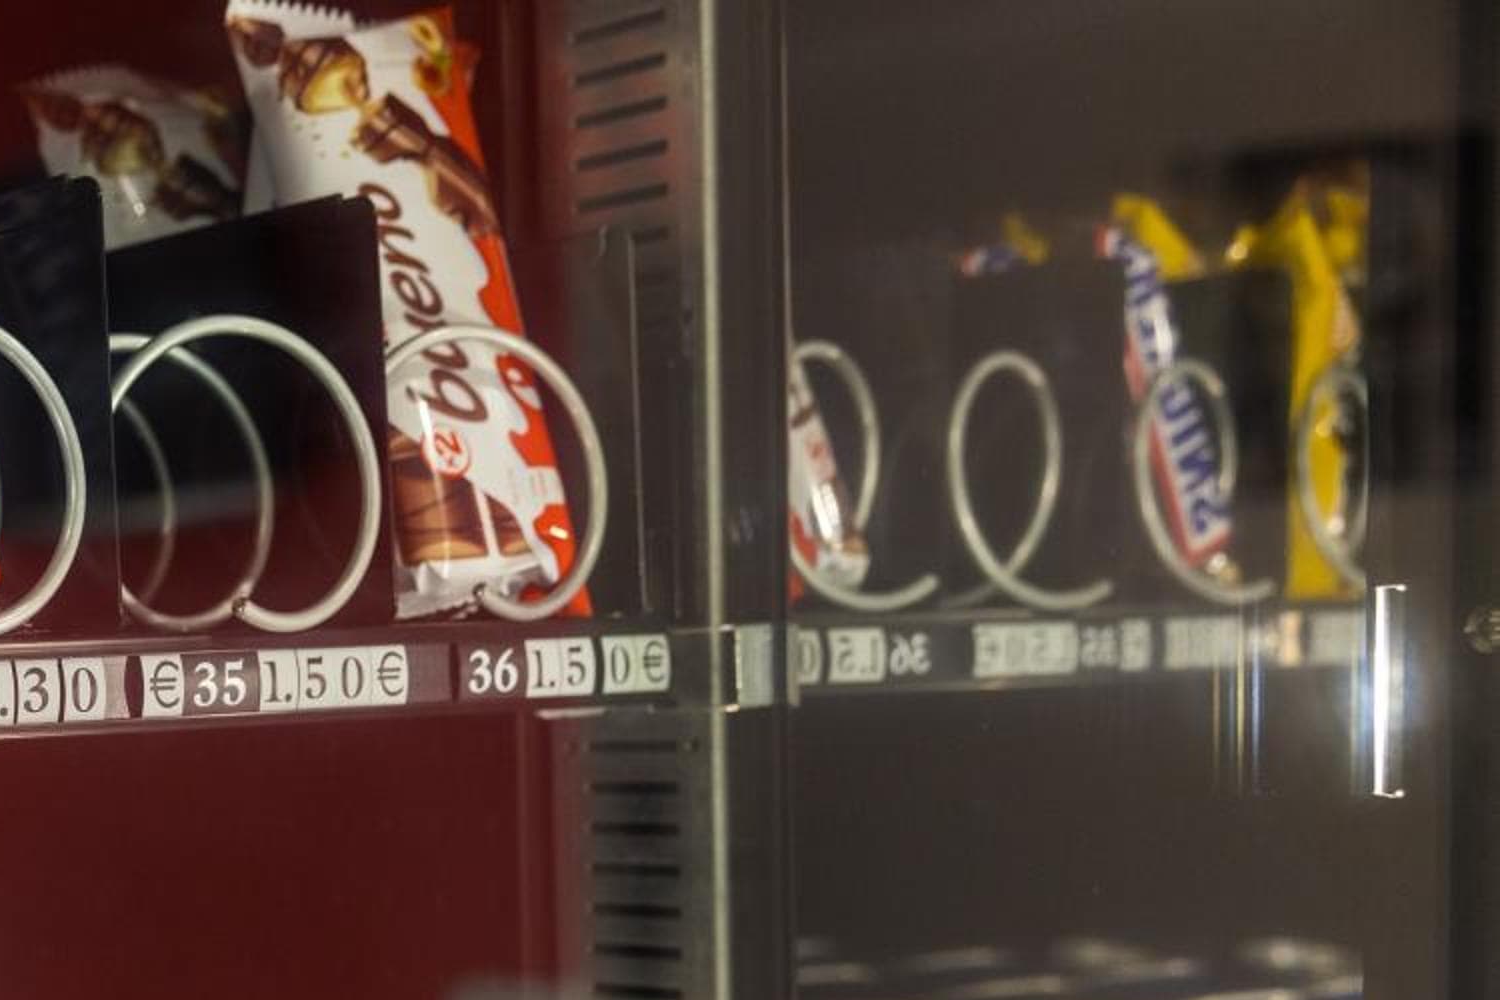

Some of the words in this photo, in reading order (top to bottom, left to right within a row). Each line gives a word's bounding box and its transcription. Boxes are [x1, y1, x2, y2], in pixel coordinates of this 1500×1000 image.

[362, 183, 489, 422] bueno
[193, 659, 247, 708] 35
[468, 648, 519, 694] 36
